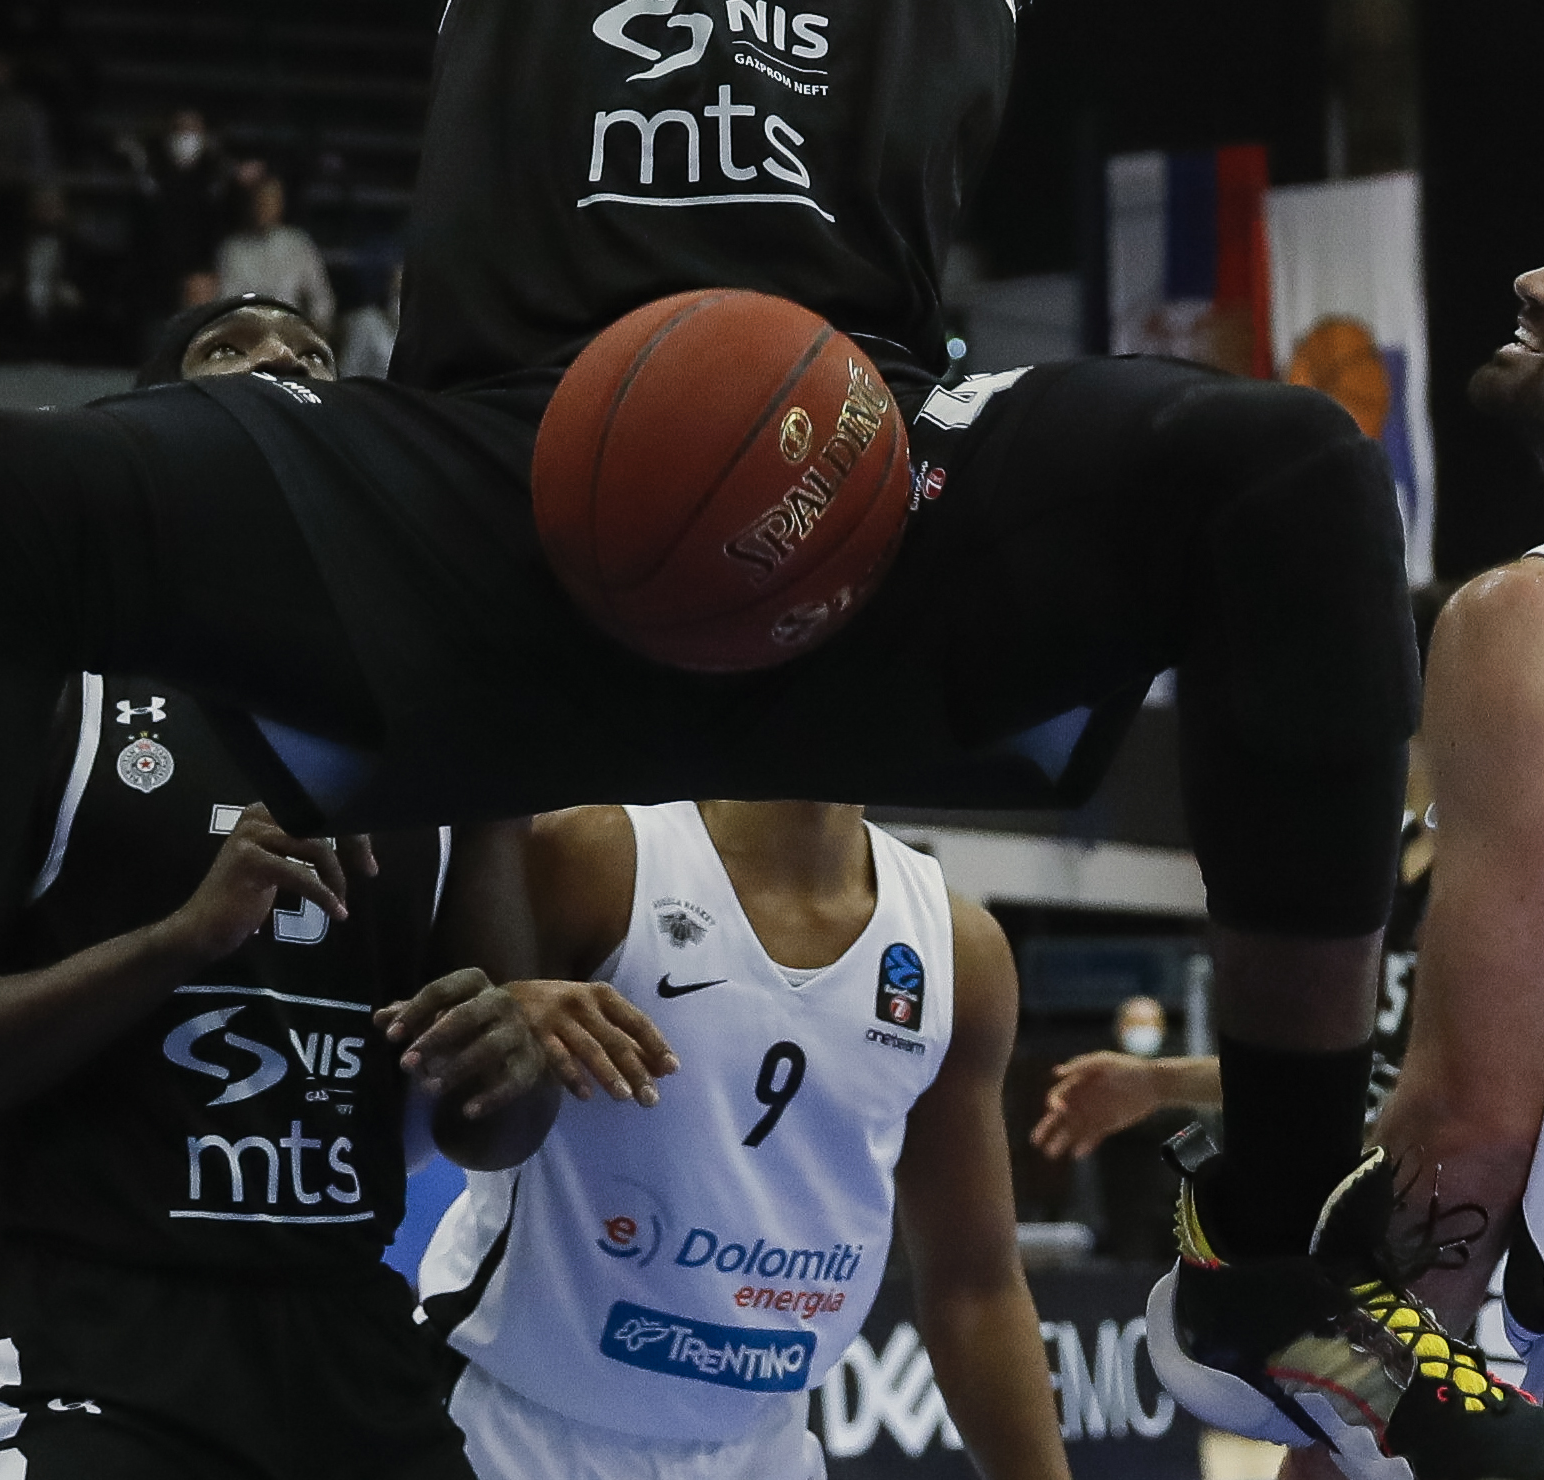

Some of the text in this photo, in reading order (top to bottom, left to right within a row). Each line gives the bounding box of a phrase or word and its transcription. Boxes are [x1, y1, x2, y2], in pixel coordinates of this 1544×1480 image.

[734, 53, 829, 96] GAZPROM NEFT
[588, 84, 811, 189] mts
[741, 1040, 807, 1148] 9
[186, 1119, 363, 1205] mts
[675, 1227, 863, 1281] Dolomiti
[734, 1284, 847, 1319] energia
[664, 1324, 806, 1383] TRENTINO
